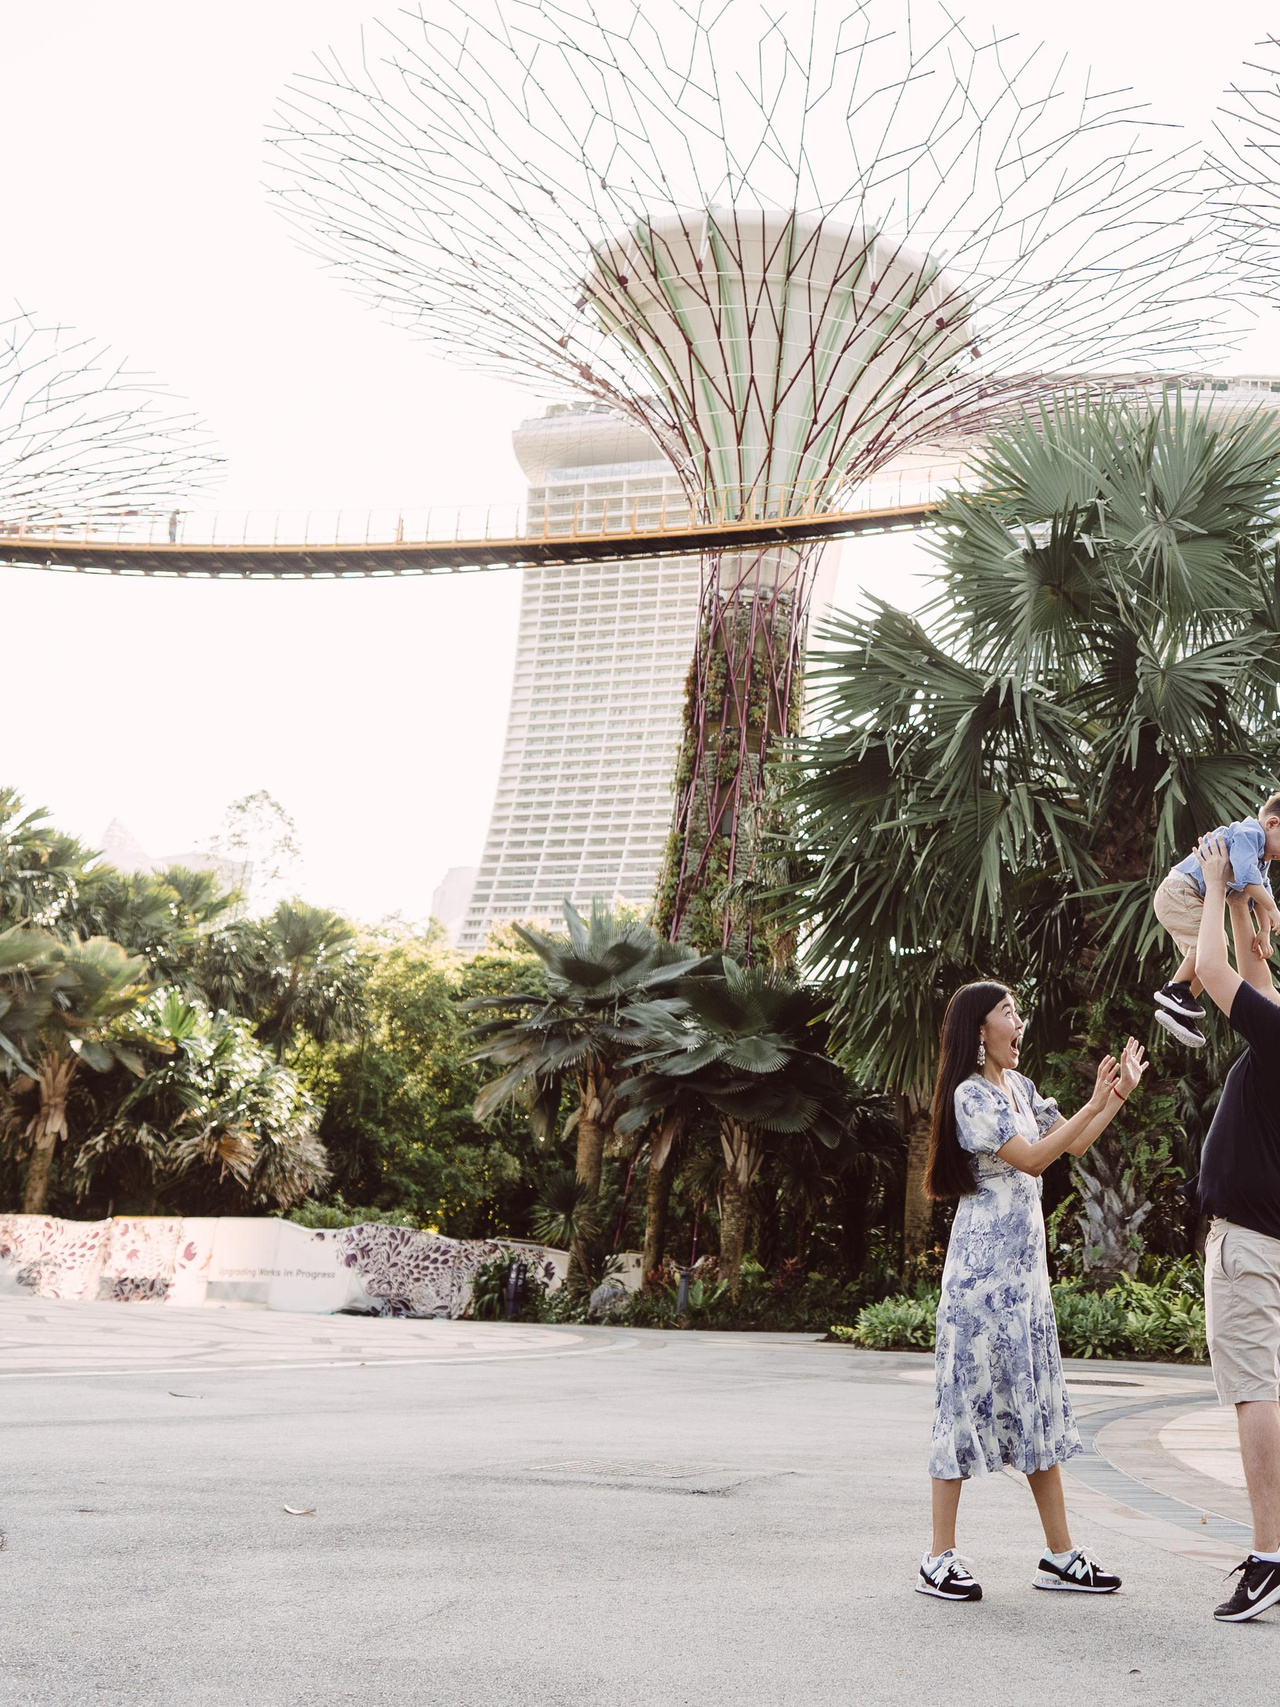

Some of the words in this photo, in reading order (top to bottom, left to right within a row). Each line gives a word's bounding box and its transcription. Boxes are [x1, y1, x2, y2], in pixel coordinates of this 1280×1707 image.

[258, 1268, 281, 1277] Works
[284, 1269, 293, 1277] in
[296, 1269, 336, 1280] Progress
[1067, 1559, 1089, 1580] N
